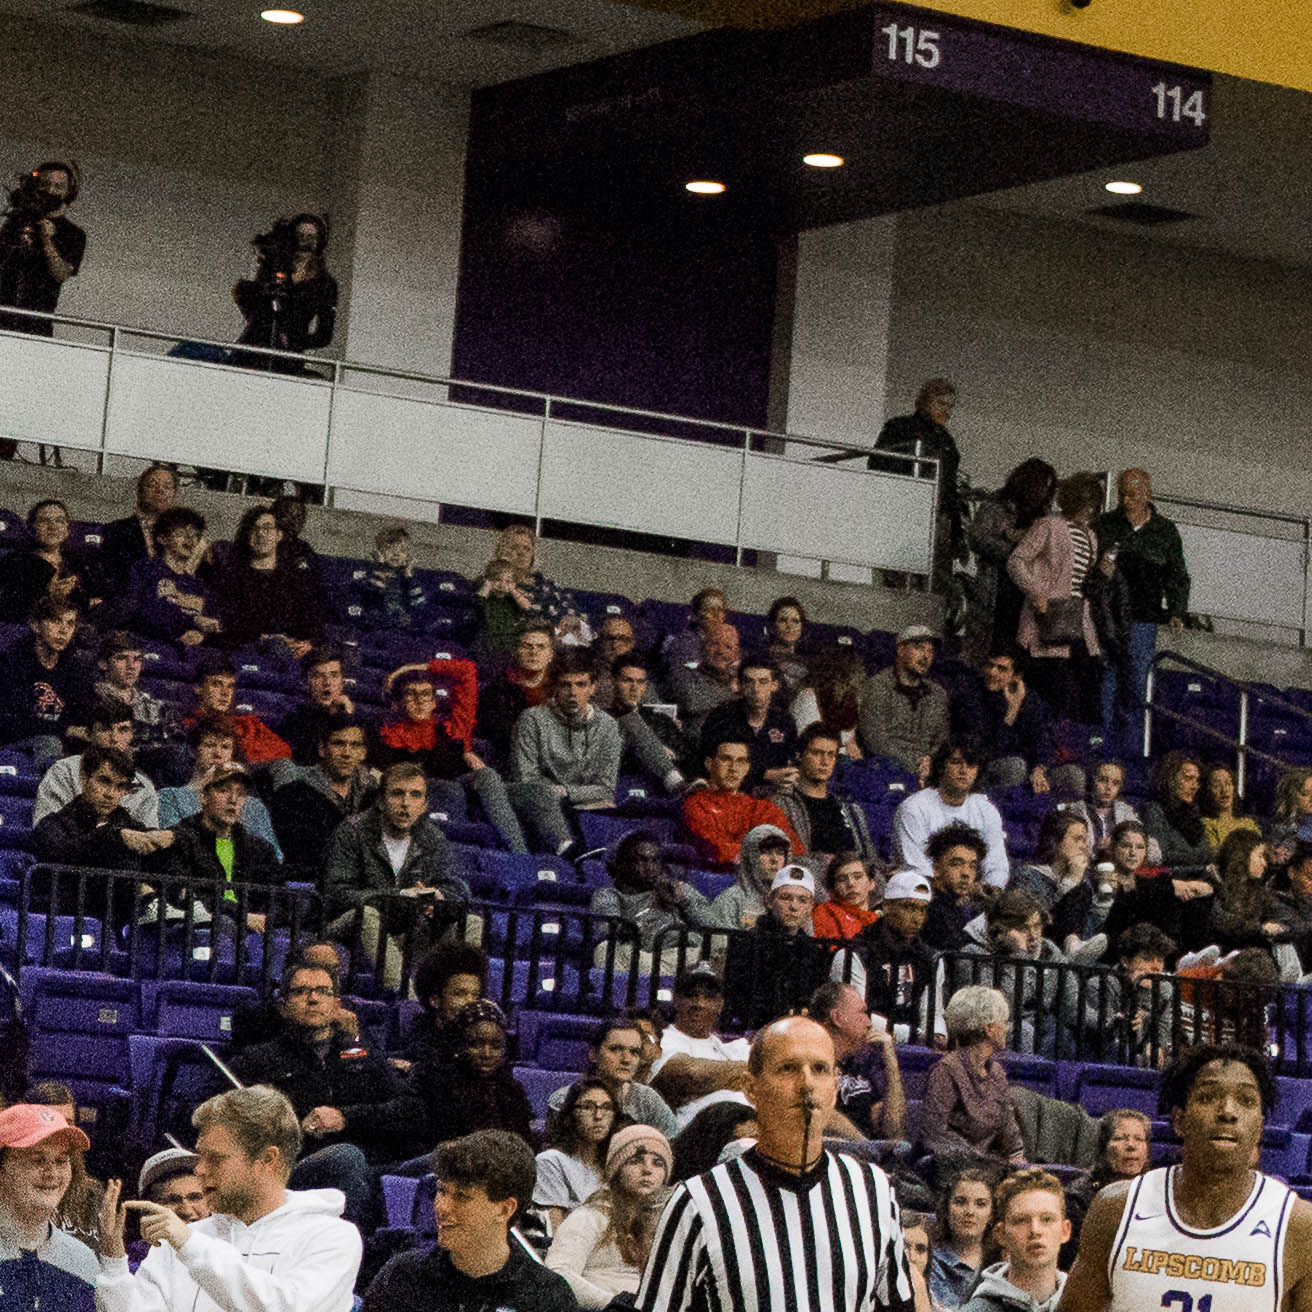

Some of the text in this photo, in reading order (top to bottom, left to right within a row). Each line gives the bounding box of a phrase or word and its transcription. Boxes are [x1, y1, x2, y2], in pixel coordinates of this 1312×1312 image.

[881, 23, 941, 68] 115
[1151, 82, 1206, 126] 114
[1122, 1246, 1267, 1288] LIPSCOMB
